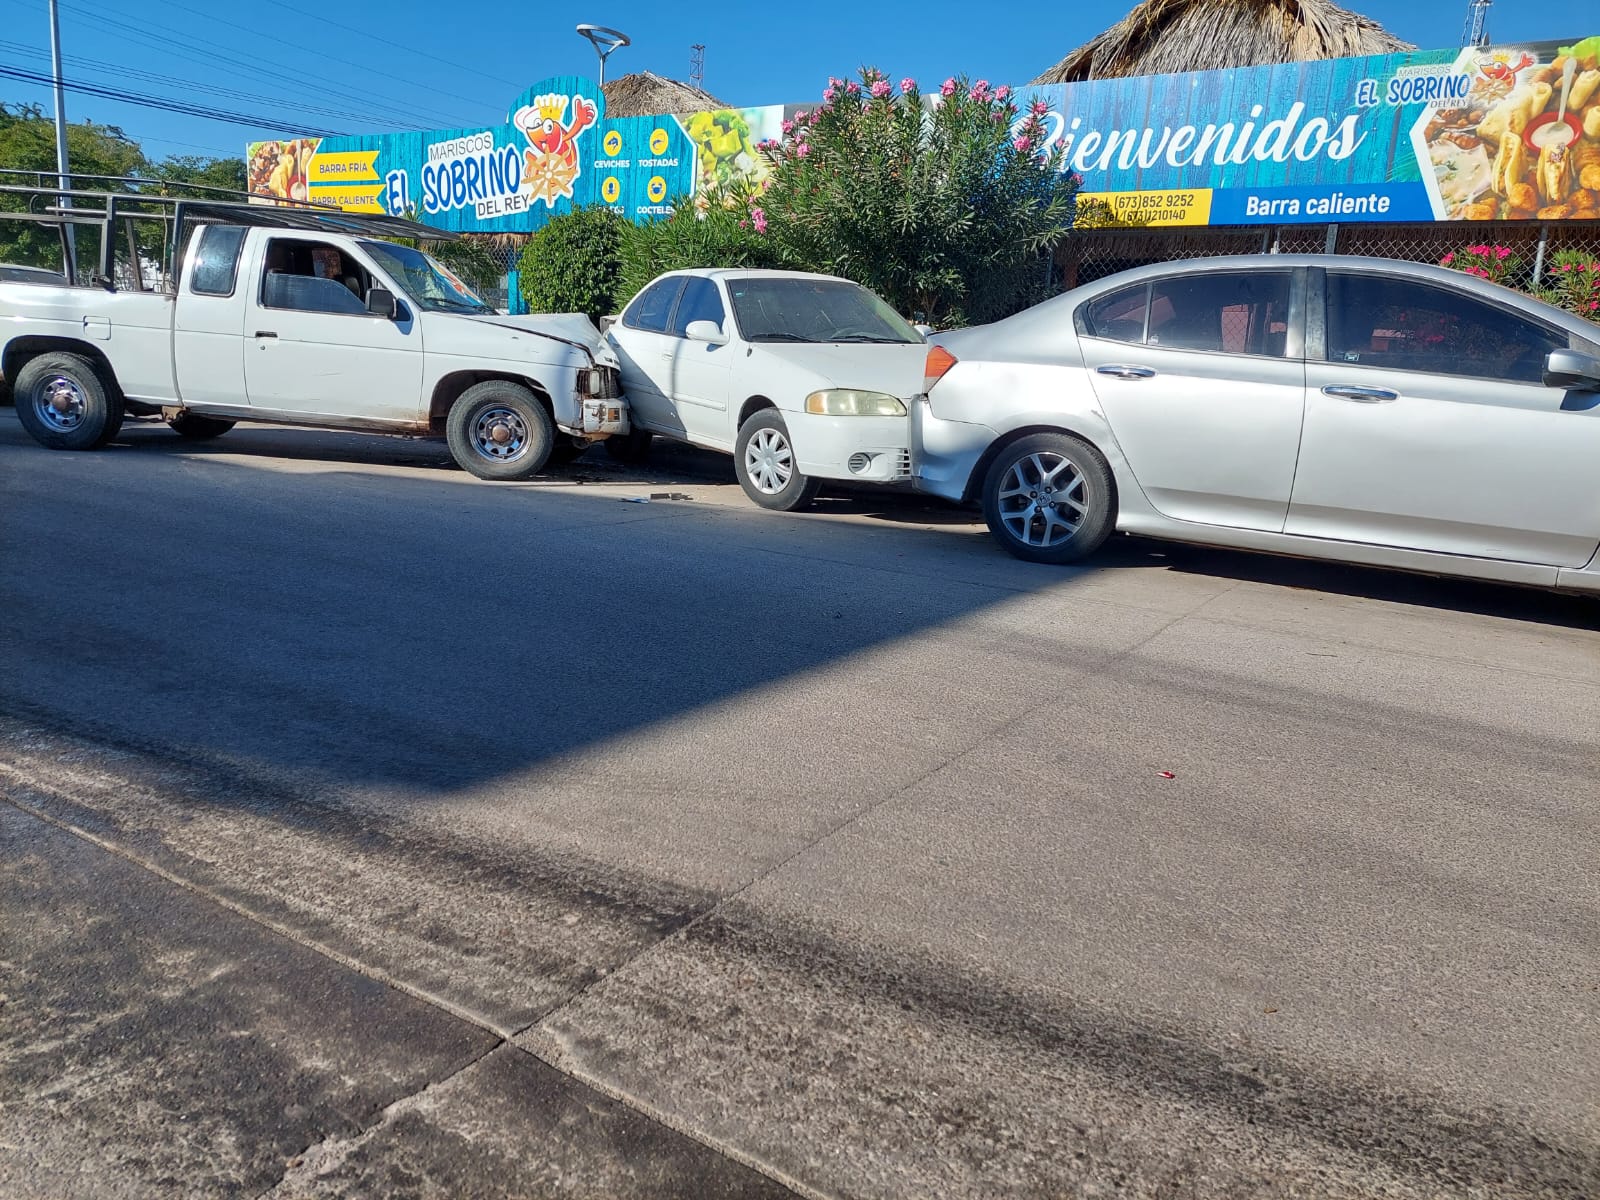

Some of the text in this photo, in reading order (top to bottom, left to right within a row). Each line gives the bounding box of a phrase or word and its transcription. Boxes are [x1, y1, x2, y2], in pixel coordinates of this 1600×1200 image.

[1358, 74, 1470, 106] EL SOBRINO
[1430, 100, 1450, 109] DEL
[430, 134, 492, 161] MARISCOS
[320, 161, 368, 174] BARRA FRÍA
[594, 160, 630, 169] CEVICHES
[638, 158, 679, 168] TOSTADAS
[388, 146, 521, 216] EL SOBRINO
[312, 195, 375, 205] BARRA CALIENTE
[477, 194, 530, 217] DEL REY
[1114, 195, 1164, 209] (673)852
[1166, 194, 1195, 207] 9252
[1246, 192, 1391, 216] Barra caliente
